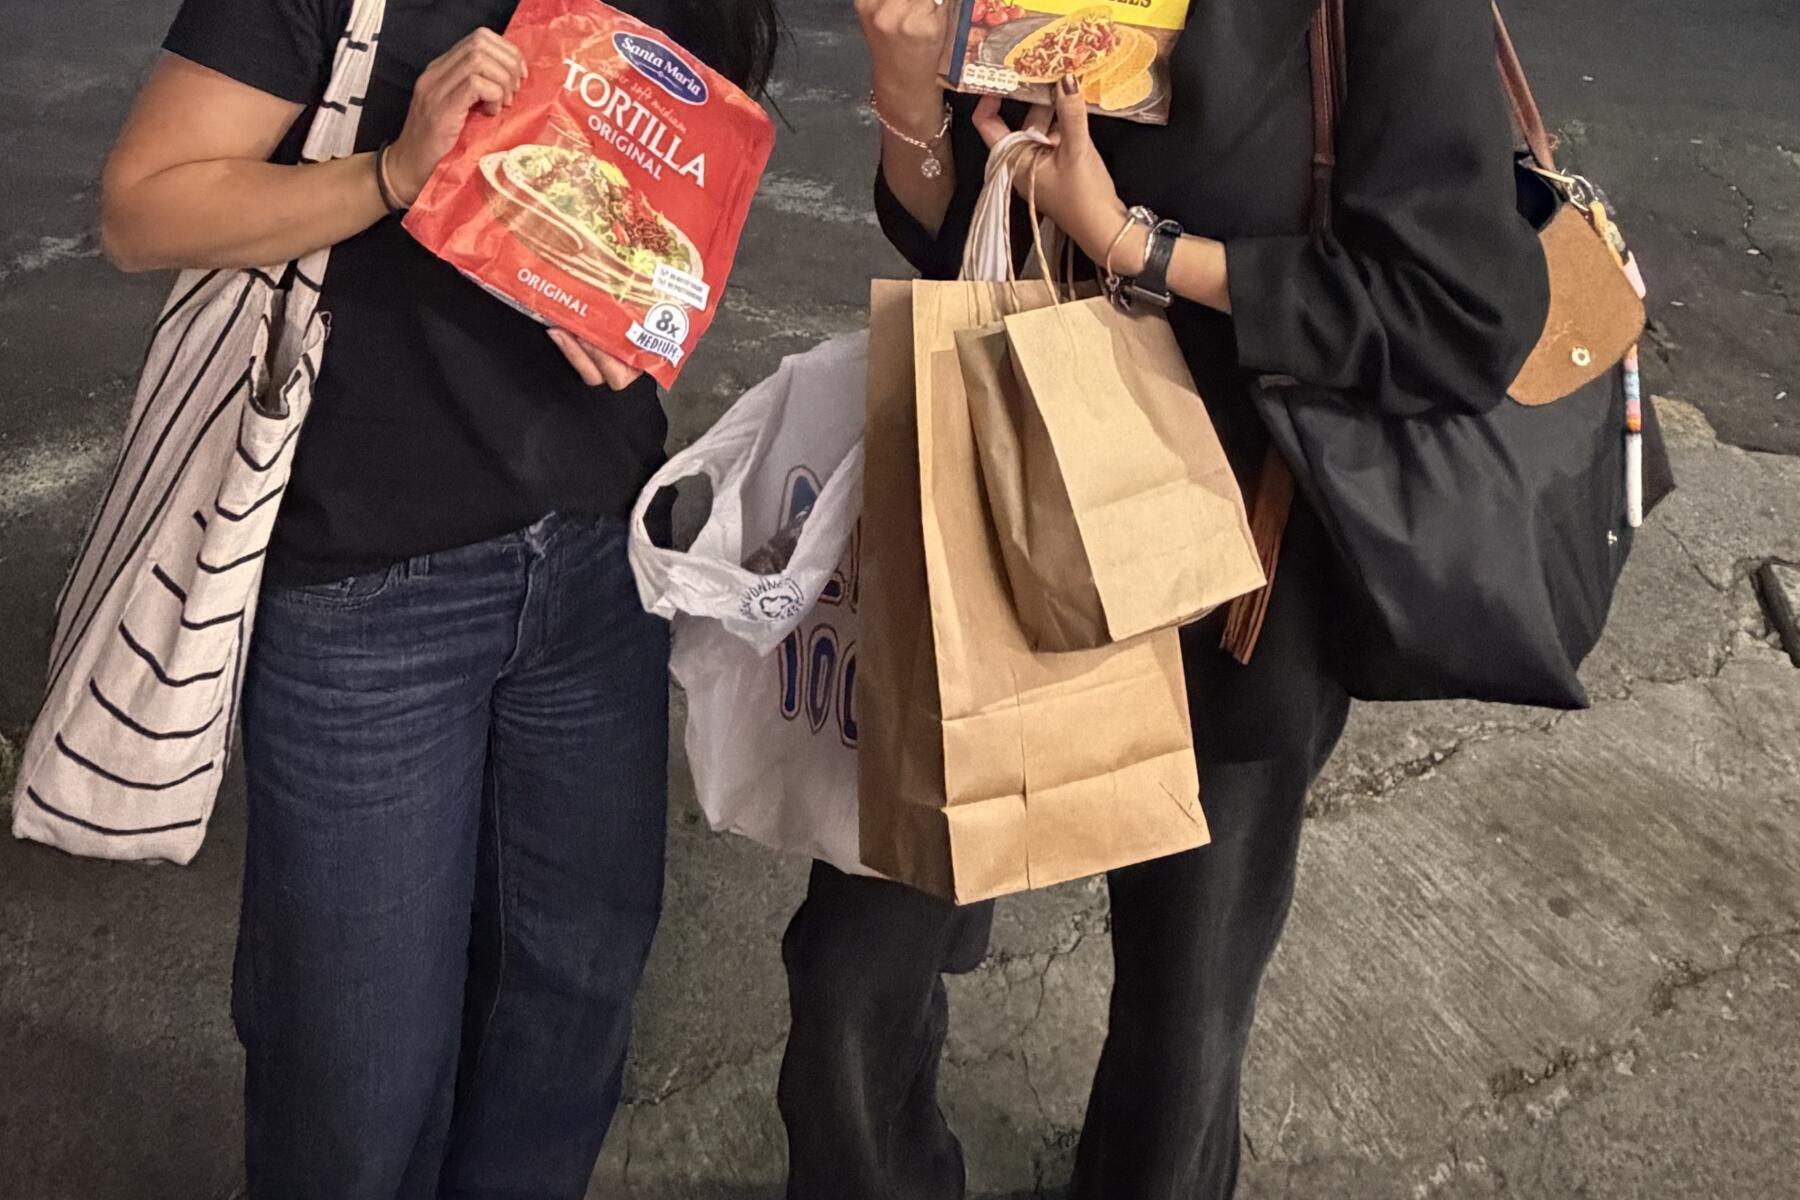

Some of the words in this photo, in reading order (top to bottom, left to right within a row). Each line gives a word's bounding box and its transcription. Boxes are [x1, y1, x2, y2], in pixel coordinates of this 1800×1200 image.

[621, 37, 663, 68] Santa
[664, 59, 702, 96] Maria
[563, 58, 705, 188] TORTILLA
[588, 114, 662, 180] ORIGINAL
[517, 268, 589, 317] ORIGINAL
[636, 331, 679, 358] MEDIUM
[655, 309, 680, 338] 8x
